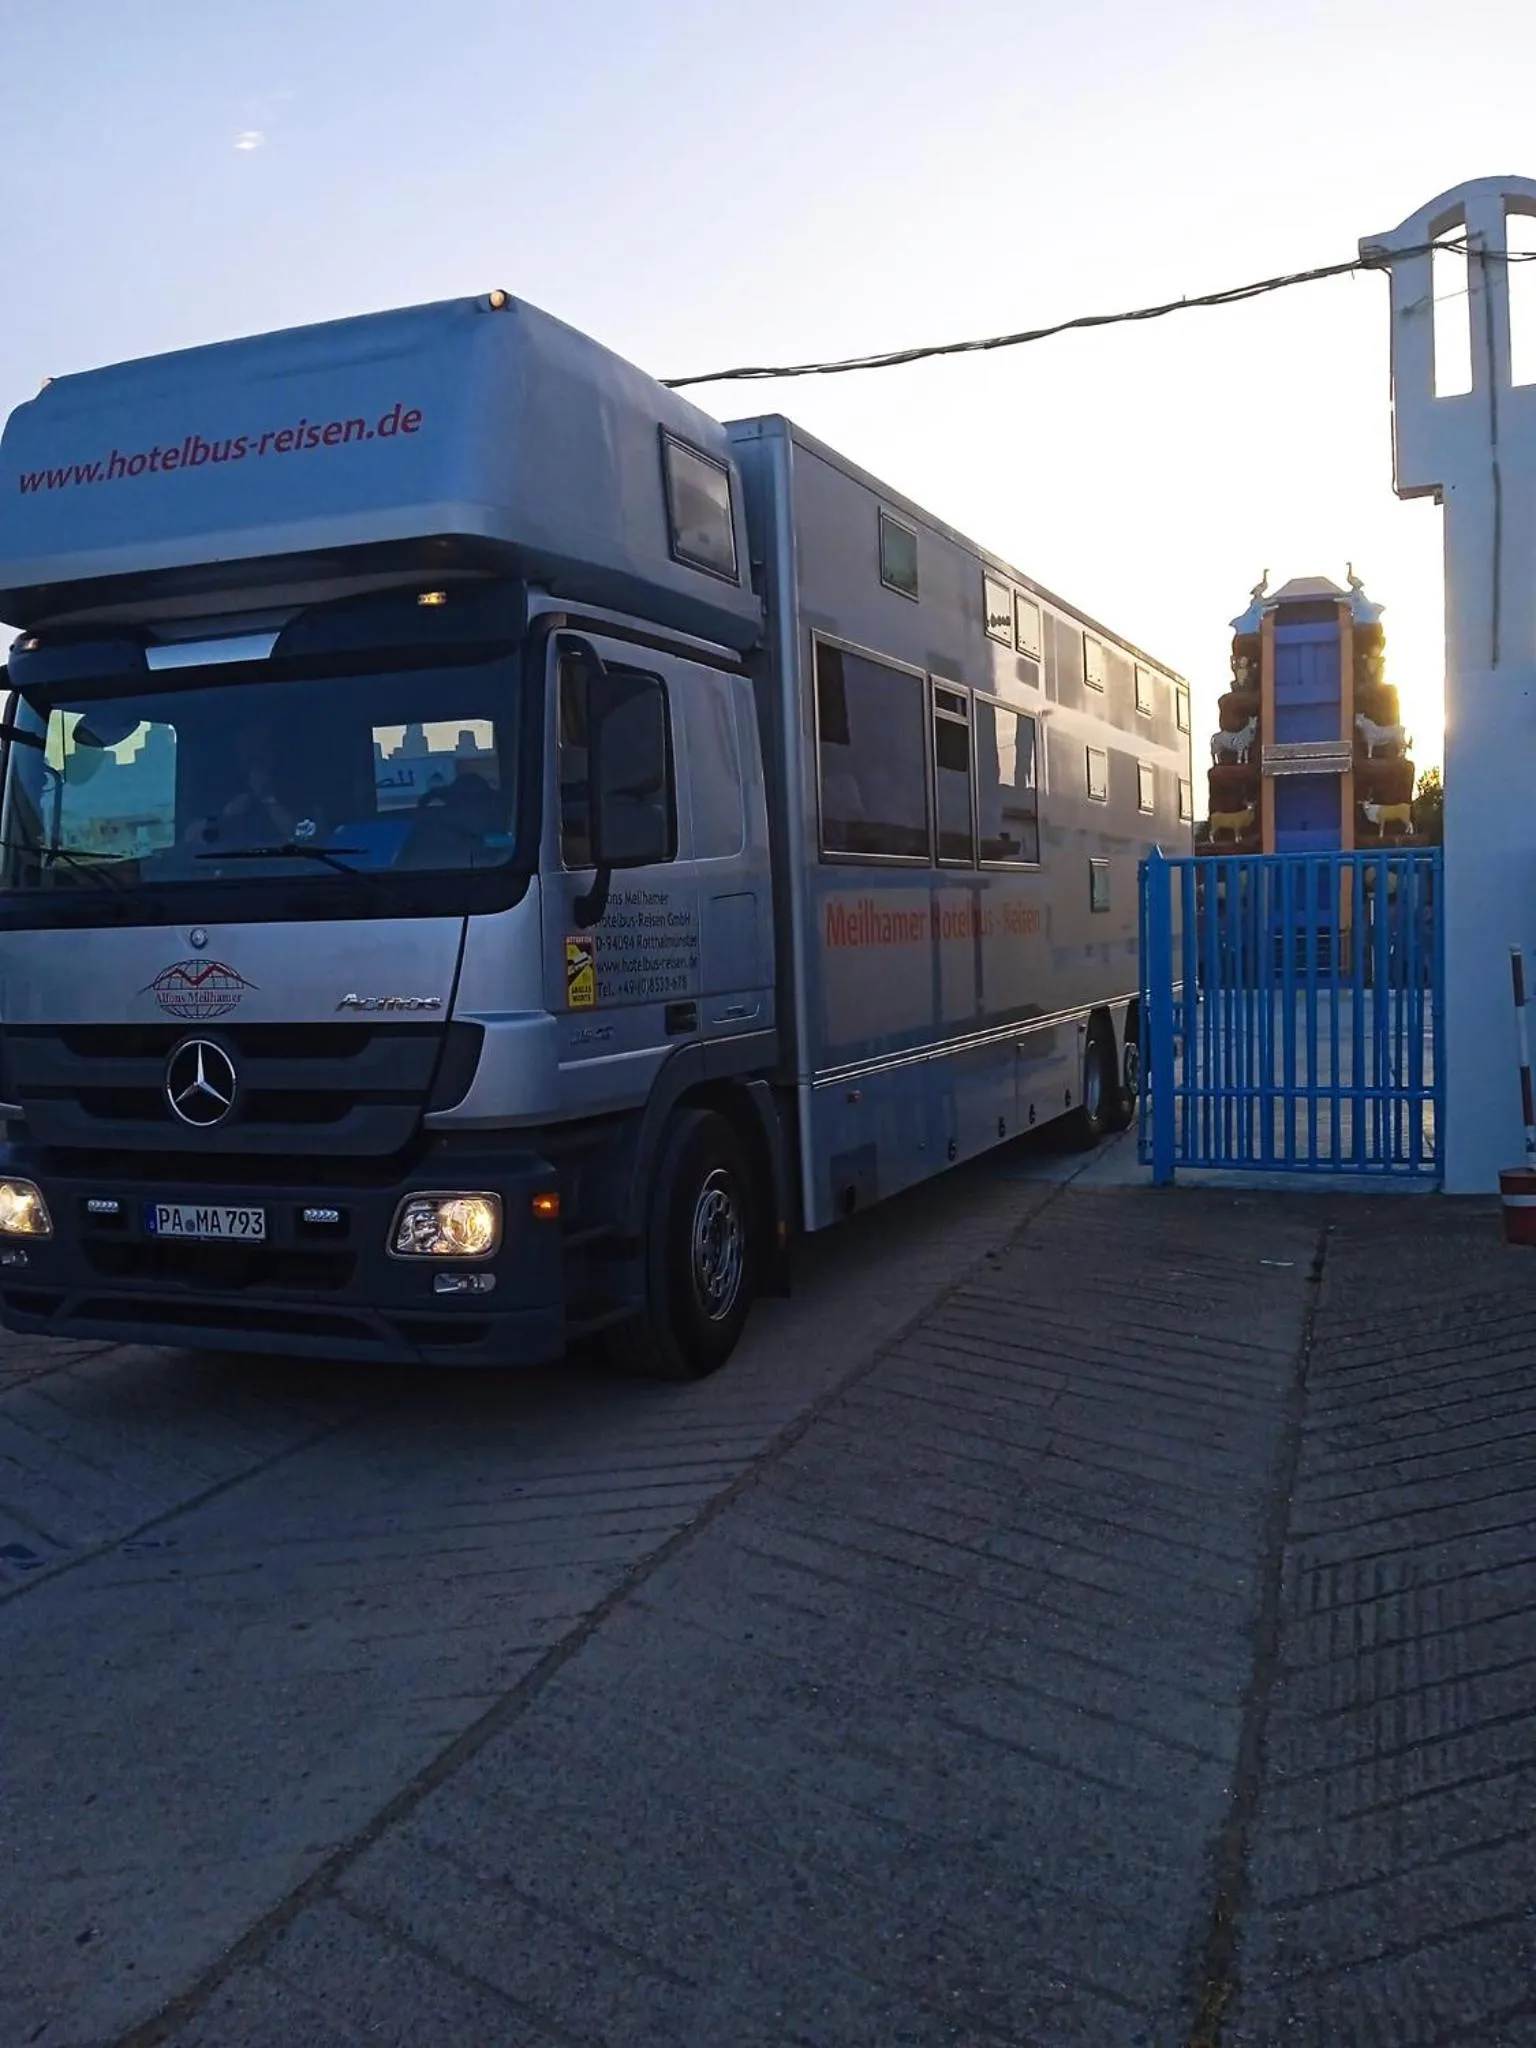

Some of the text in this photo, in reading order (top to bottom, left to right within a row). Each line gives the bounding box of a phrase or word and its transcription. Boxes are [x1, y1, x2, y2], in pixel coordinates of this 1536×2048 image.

[19, 403, 423, 494] www.hotelbus-reisen.de
[667, 911, 691, 927] GmbH
[826, 898, 927, 948] Meilhamer
[187, 990, 243, 1004] Meilhamer
[597, 981, 615, 997] Tel.
[335, 993, 442, 1012] Actros
[158, 1206, 263, 1235] PA MA 793
